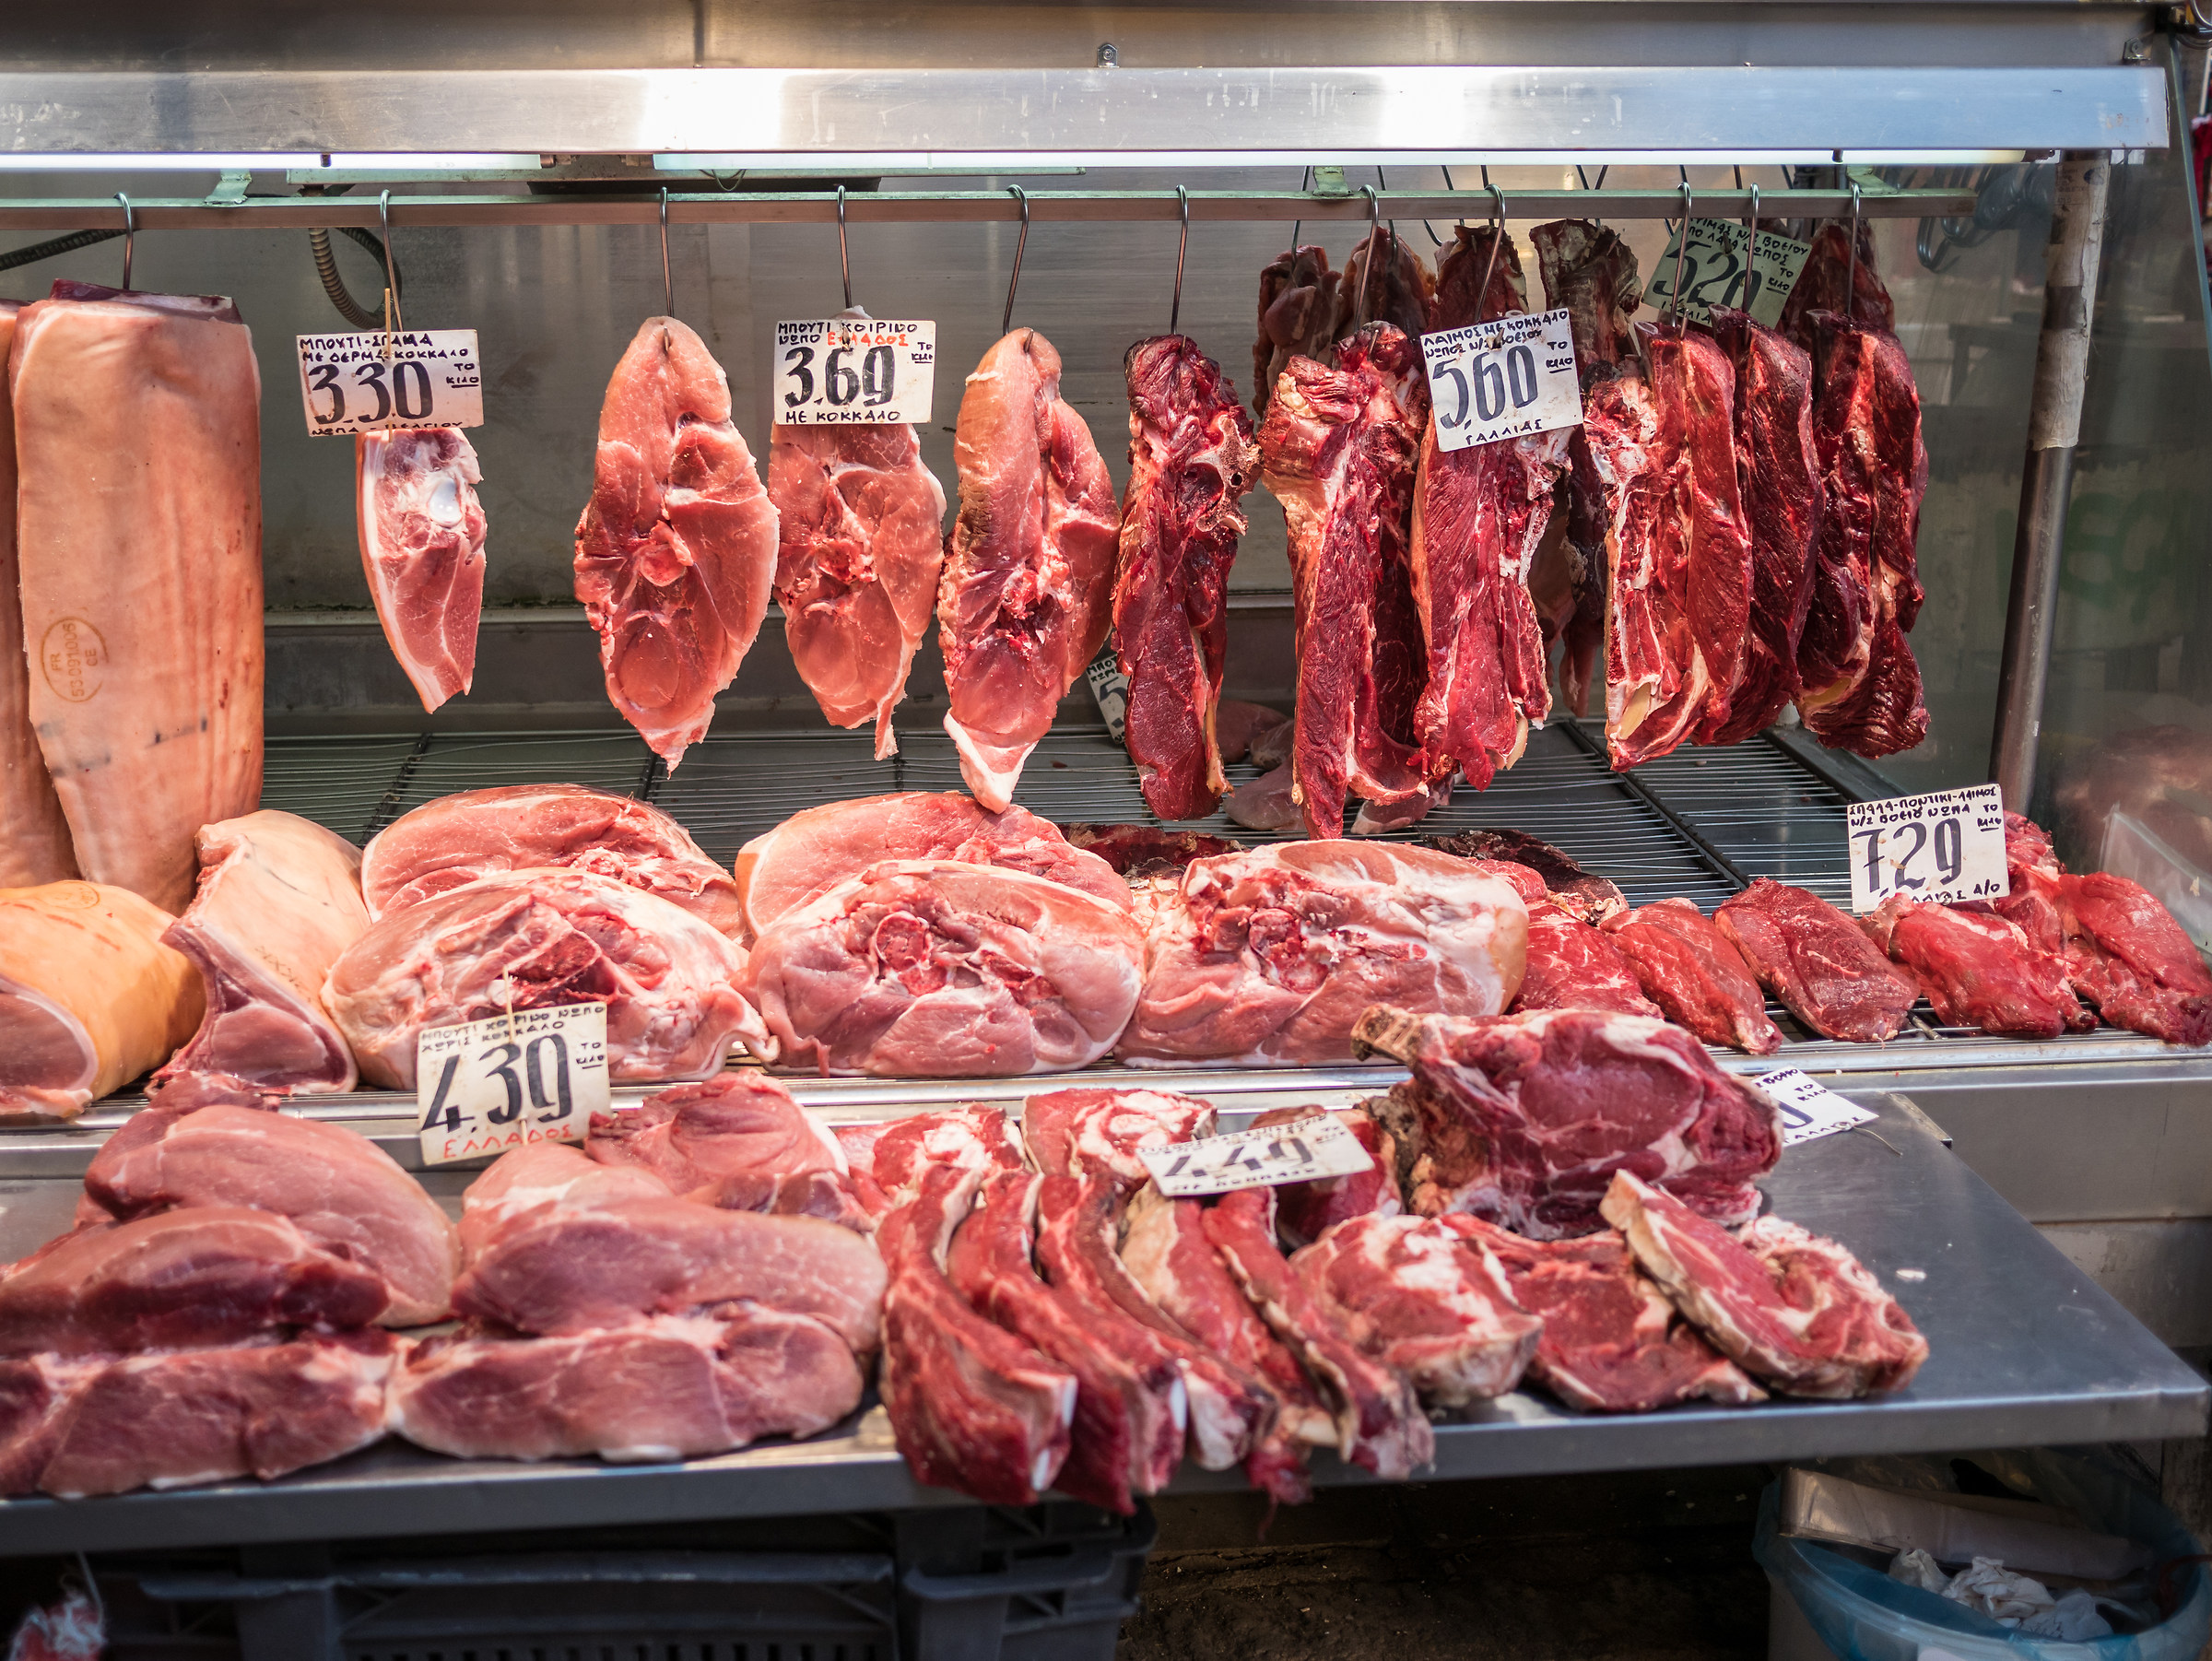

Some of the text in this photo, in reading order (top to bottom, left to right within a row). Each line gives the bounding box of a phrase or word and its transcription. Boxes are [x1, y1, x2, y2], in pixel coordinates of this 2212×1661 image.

[1681, 226, 1703, 237] ΠΟ
[1780, 267, 1794, 277] ΤΟ
[778, 323, 830, 334] ΜΠΟΥΤΙ
[1424, 326, 1481, 347] ΛΑΙΜΟΣ
[1507, 311, 1568, 330] ΚΟΚΚΑΛΟ
[779, 335, 820, 346] ΝΩΠΟ
[918, 342, 933, 350] ΤΟ
[302, 352, 323, 362] ΜΕ
[394, 348, 468, 359] ΚΟΚΚΑΛΟ
[1546, 358, 1573, 369] ΚΙΛΟ
[446, 376, 479, 384] ΚΙΛΟ
[786, 410, 900, 424] ΜΕ ΚΟΚΚΑΛΟ
[1465, 419, 1542, 445] ΓΑΛΛΙΑΣ
[50, 653, 61, 671] FR
[85, 649, 98, 666] CE
[421, 1025, 477, 1040] ΜΠΟΥΤΙ
[559, 1007, 605, 1018] ΝΩΠΟ
[422, 1038, 472, 1053] ΧΩΡΙΣ
